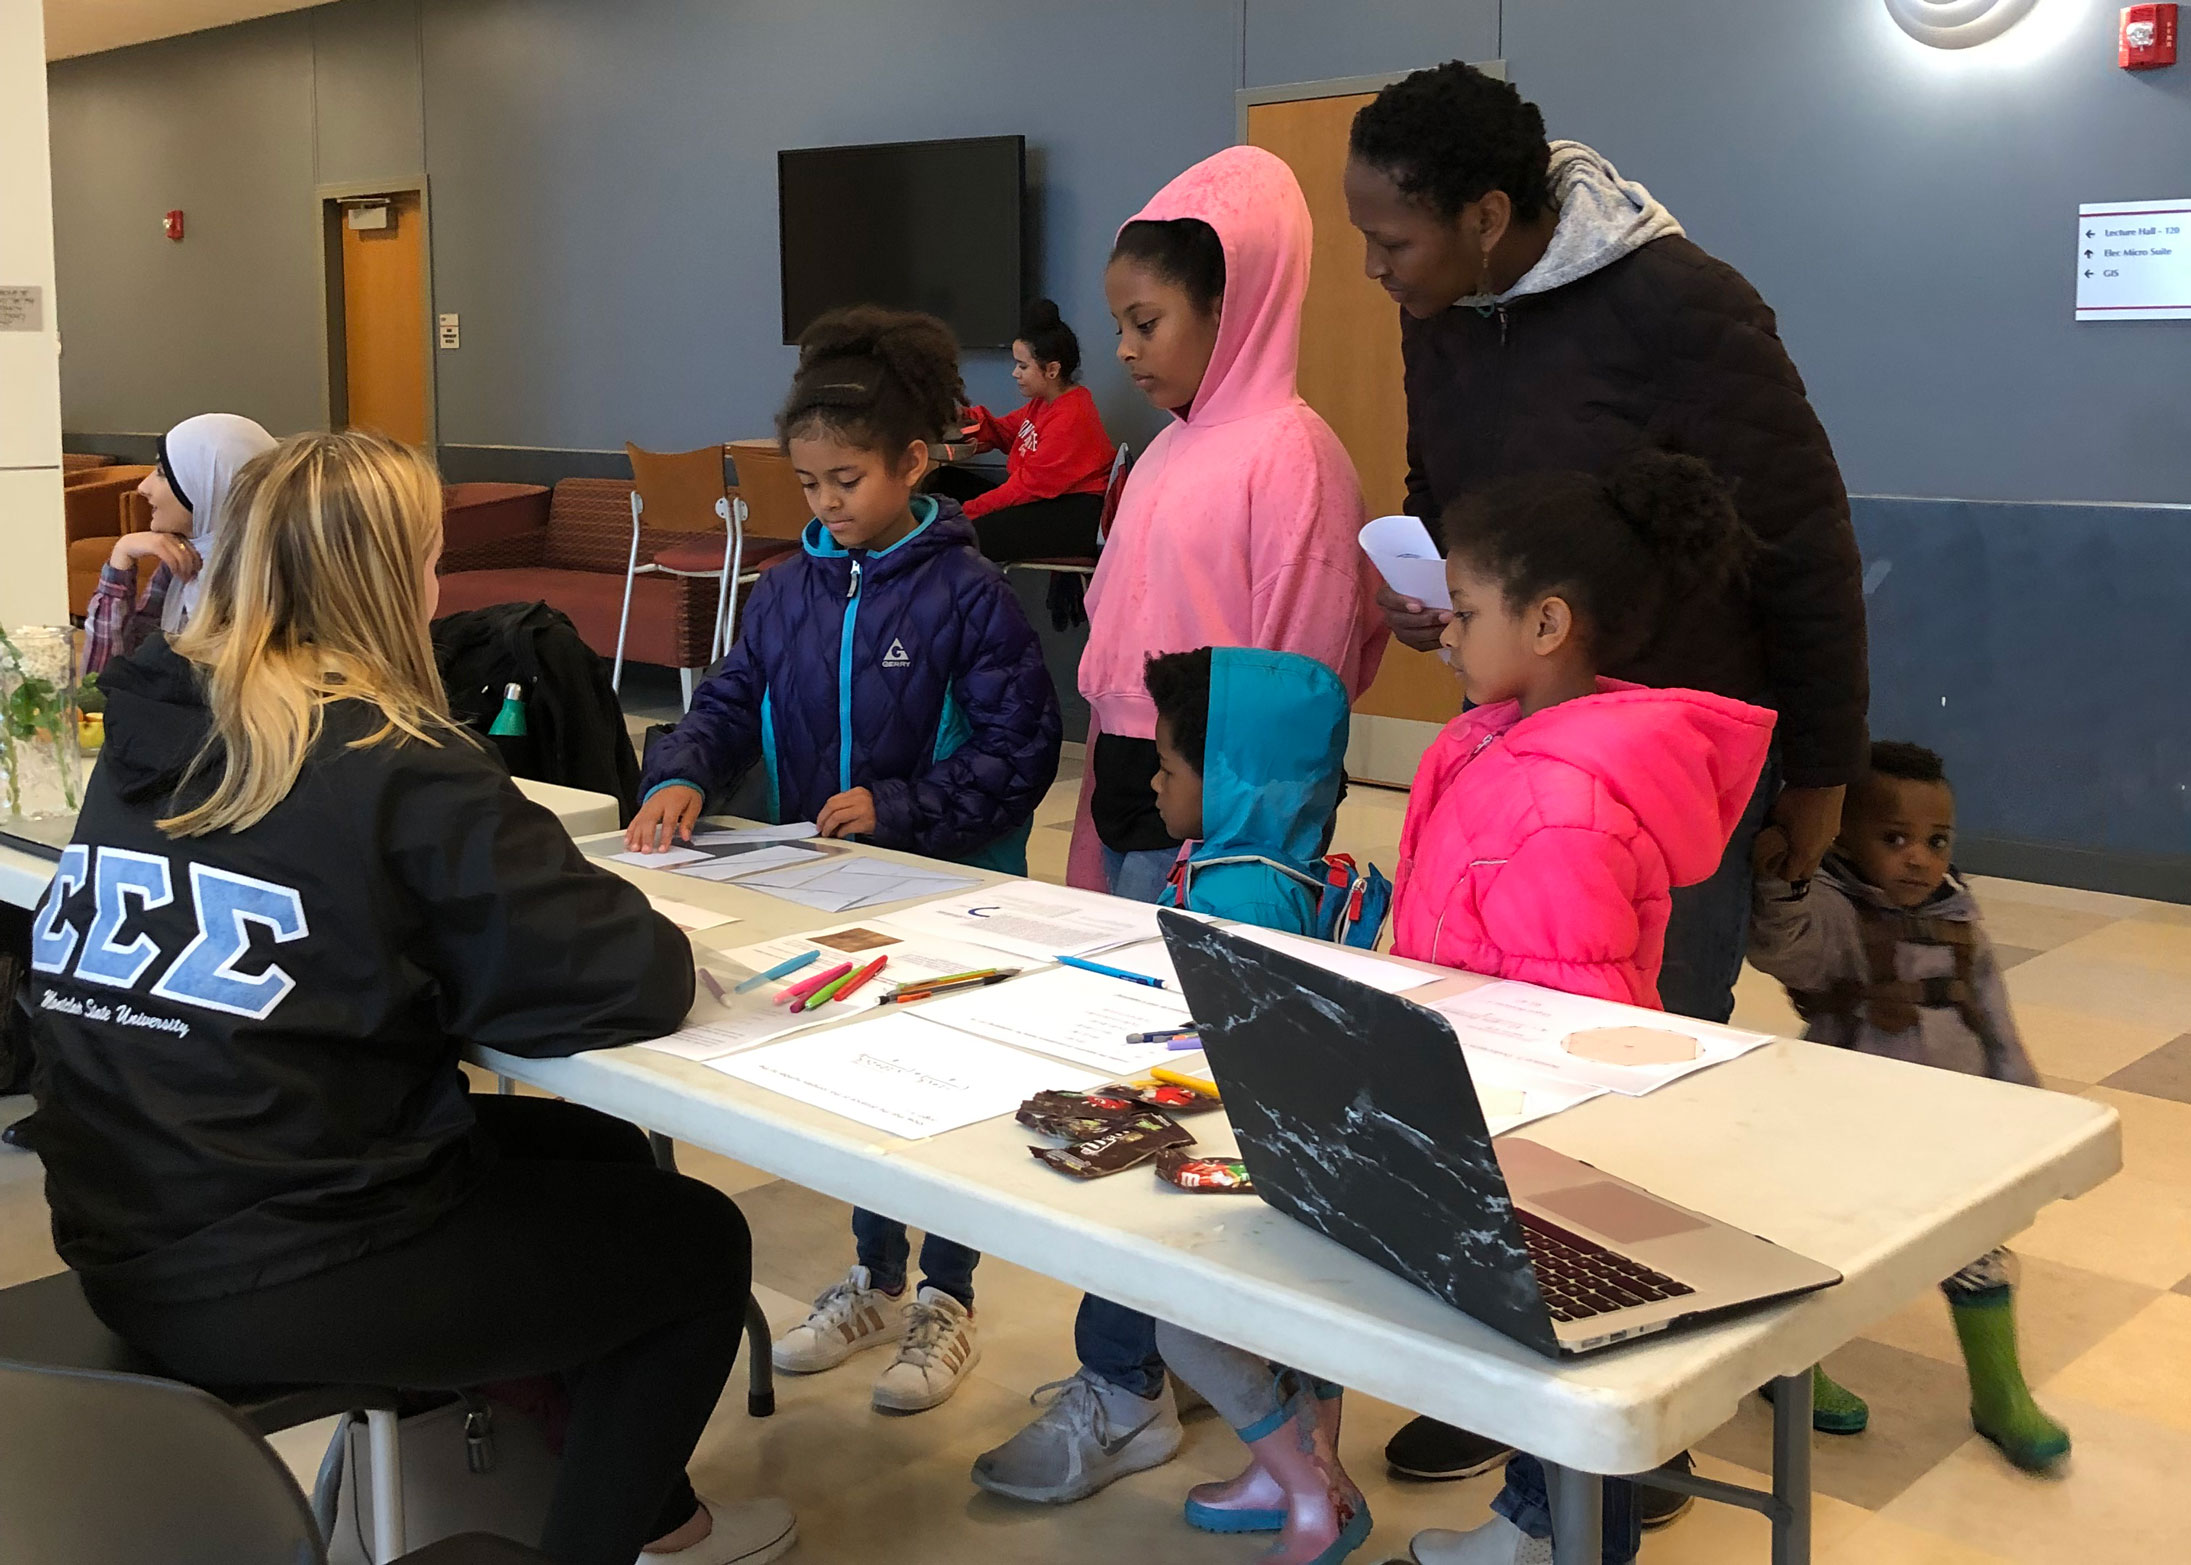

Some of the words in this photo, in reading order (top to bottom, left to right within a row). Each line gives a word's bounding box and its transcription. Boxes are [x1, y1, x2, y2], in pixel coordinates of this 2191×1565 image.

[2104, 229, 2137, 237] Lecture
[2138, 227, 2156, 236] Hall
[2165, 227, 2181, 235] 120
[2104, 249, 2121, 257] Elec
[2123, 248, 2148, 257] Micro
[2150, 248, 2172, 256] Suite
[2103, 269, 2119, 277] GIS
[84, 998, 112, 1022] State
[115, 1004, 190, 1039] University
